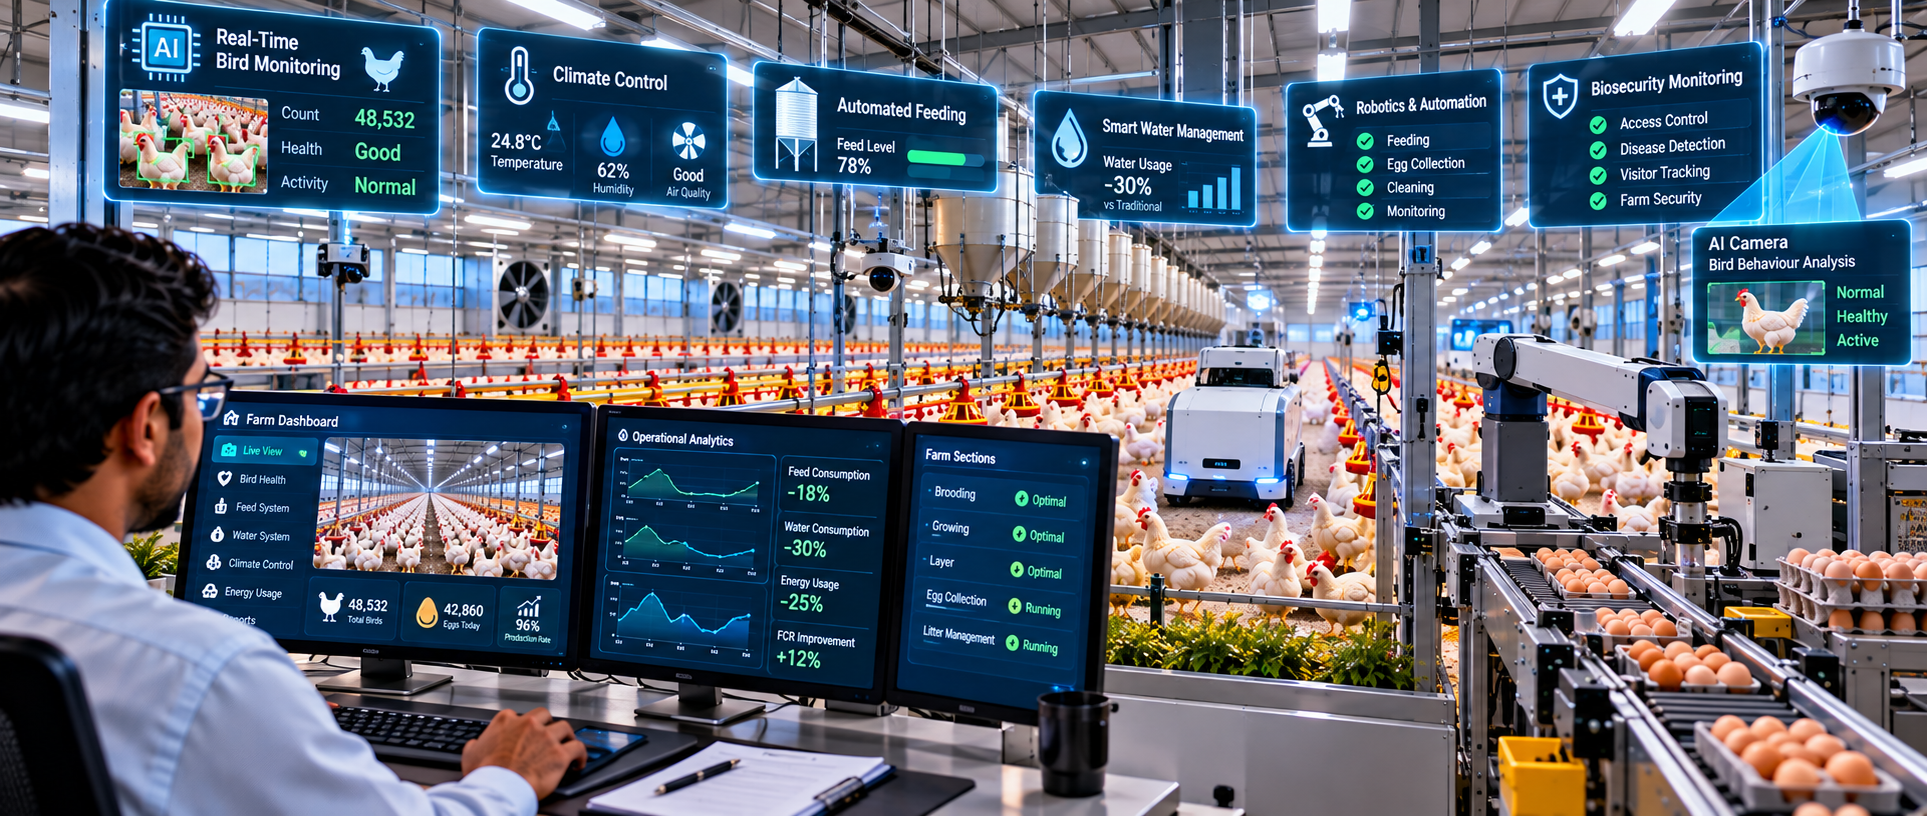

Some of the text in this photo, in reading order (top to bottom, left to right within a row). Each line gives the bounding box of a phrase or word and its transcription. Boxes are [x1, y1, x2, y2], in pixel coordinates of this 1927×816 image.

[216, 28, 299, 50] Real-Time
[154, 38, 178, 58] AI
[216, 53, 340, 80] Bird Monitoring
[553, 66, 667, 90] Climate Control
[1592, 69, 1743, 96] Biosecurity Monitoring
[837, 97, 966, 125] Automated Feeding
[1357, 94, 1486, 114] Robotics & Automation
[282, 106, 415, 129] Count 48,532
[1620, 111, 1707, 130] Access Control
[1103, 119, 1244, 142] Smart Water Management
[491, 133, 541, 150] 24.8°C
[837, 138, 895, 153] Feed Level
[1387, 134, 1429, 148] Feeding
[1621, 138, 1725, 155] Disease Detection
[282, 141, 401, 162] Health Good
[491, 155, 563, 171] Temperature
[597, 163, 629, 178] 62%
[837, 157, 871, 174] 78%
[1103, 156, 1172, 173] Water Usage
[1387, 157, 1465, 172] Egg Collection
[673, 167, 703, 182] Good
[1621, 165, 1710, 181] Visitor Tracking
[281, 175, 416, 195] Activity Normal
[593, 183, 634, 197] Humidity
[1104, 176, 1151, 195] -30%
[1387, 181, 1434, 195] Cleaning
[666, 187, 711, 201] Air Quality
[1621, 191, 1701, 206] Farm Security
[1104, 200, 1162, 212] vs Traditional
[1387, 205, 1445, 219] Monitoring
[1709, 236, 1788, 250] AI Camera
[1709, 255, 1855, 271] Bird Behaviour Analysis
[1837, 285, 1884, 299] Normal
[1837, 309, 1888, 326] Healthy
[1837, 334, 1879, 347] Active
[247, 414, 338, 428] Farm Dashboard
[632, 431, 733, 447] Operational Analytics
[243, 445, 283, 456] Live View
[926, 449, 996, 464] Farm Sections
[240, 474, 286, 485] Bird Health
[788, 466, 870, 481] Feed Consumption
[788, 485, 830, 502] -18%
[935, 486, 1066, 507] Brooding Optimal
[236, 502, 289, 514] Feed System
[232, 530, 290, 543] Water System
[784, 521, 869, 537] Water Consumption
[932, 521, 1064, 543] Growing Optimal
[784, 540, 826, 557] -30%
[228, 558, 294, 571] Climate Control
[930, 555, 1062, 579] Layer Optimal
[781, 575, 839, 590] Energy Usage
[225, 586, 282, 601] Energy Usage
[349, 599, 388, 612] 48,532
[444, 604, 483, 617] 42,860
[780, 594, 823, 612] -25%
[927, 589, 1061, 619] Egg Collection Running
[516, 619, 540, 631] 96%
[777, 630, 855, 648] FCR Improvement
[923, 625, 1058, 656] Litter Management Running
[777, 649, 820, 668] +12%
